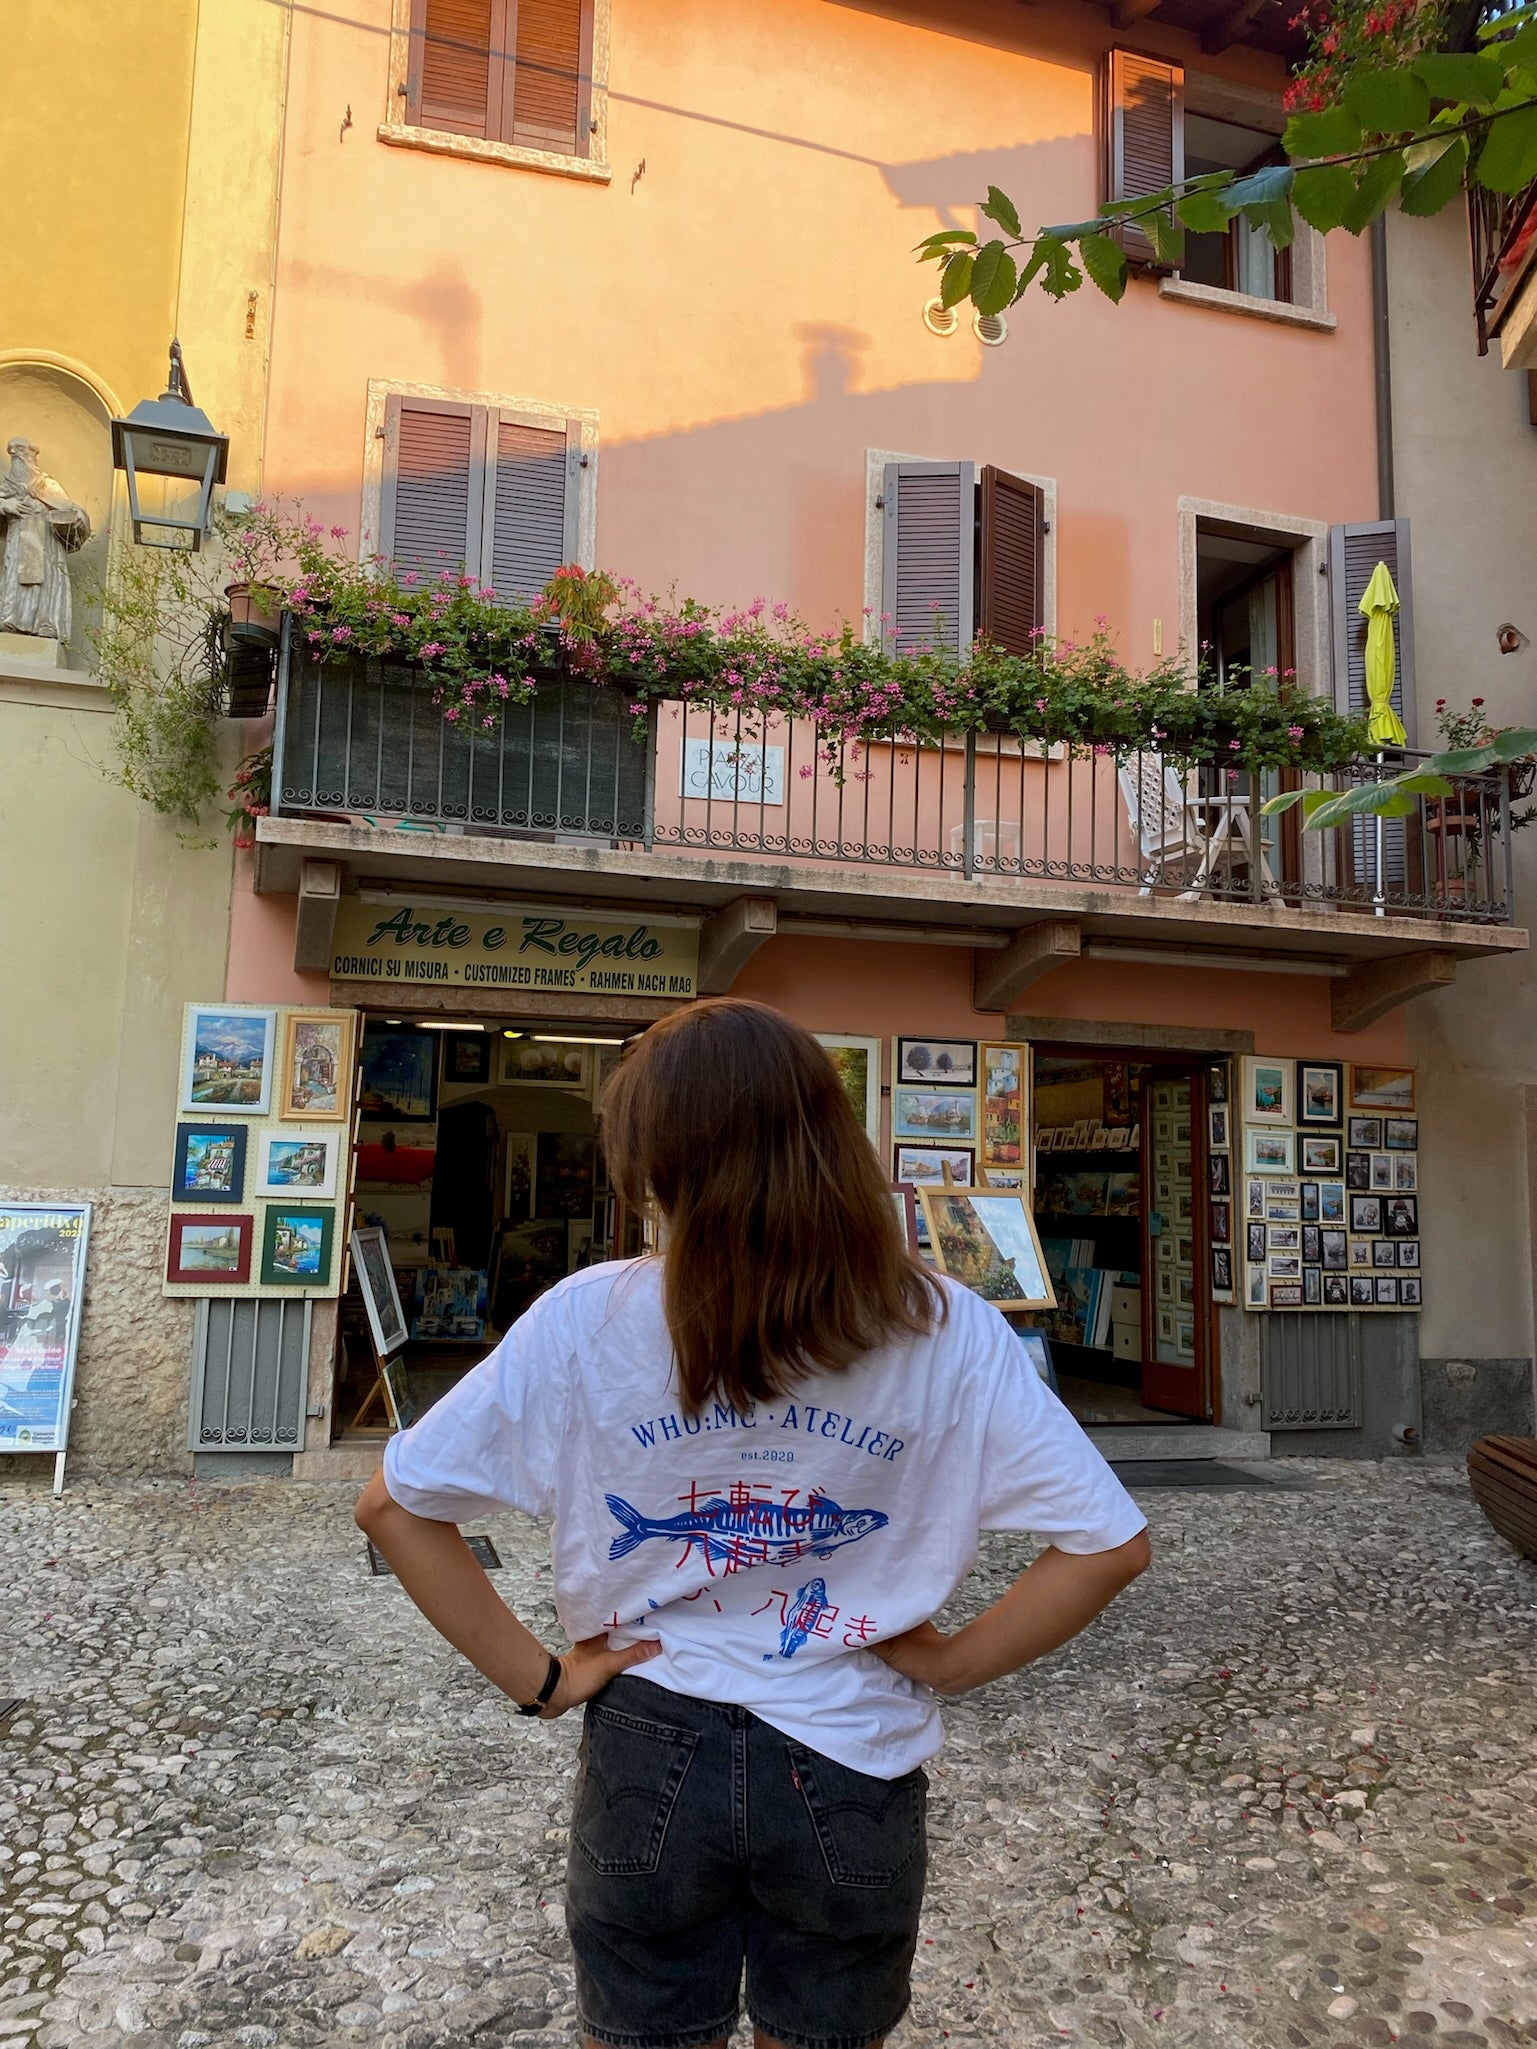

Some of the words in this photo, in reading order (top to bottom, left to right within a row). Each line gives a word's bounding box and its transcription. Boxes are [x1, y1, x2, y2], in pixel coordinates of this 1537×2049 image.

[690, 770, 774, 794] CAVOUR
[367, 907, 472, 949] Arte
[482, 925, 507, 950] e
[519, 916, 664, 971] Regalo
[334, 956, 382, 976] CORNICI
[386, 959, 401, 977] SU
[404, 960, 449, 980] MISURA
[464, 963, 532, 985] CUSTOMIZED
[533, 968, 576, 988] FRAMES
[589, 971, 635, 990] RAHMEN
[780, 1404, 905, 1462] ATELIER
